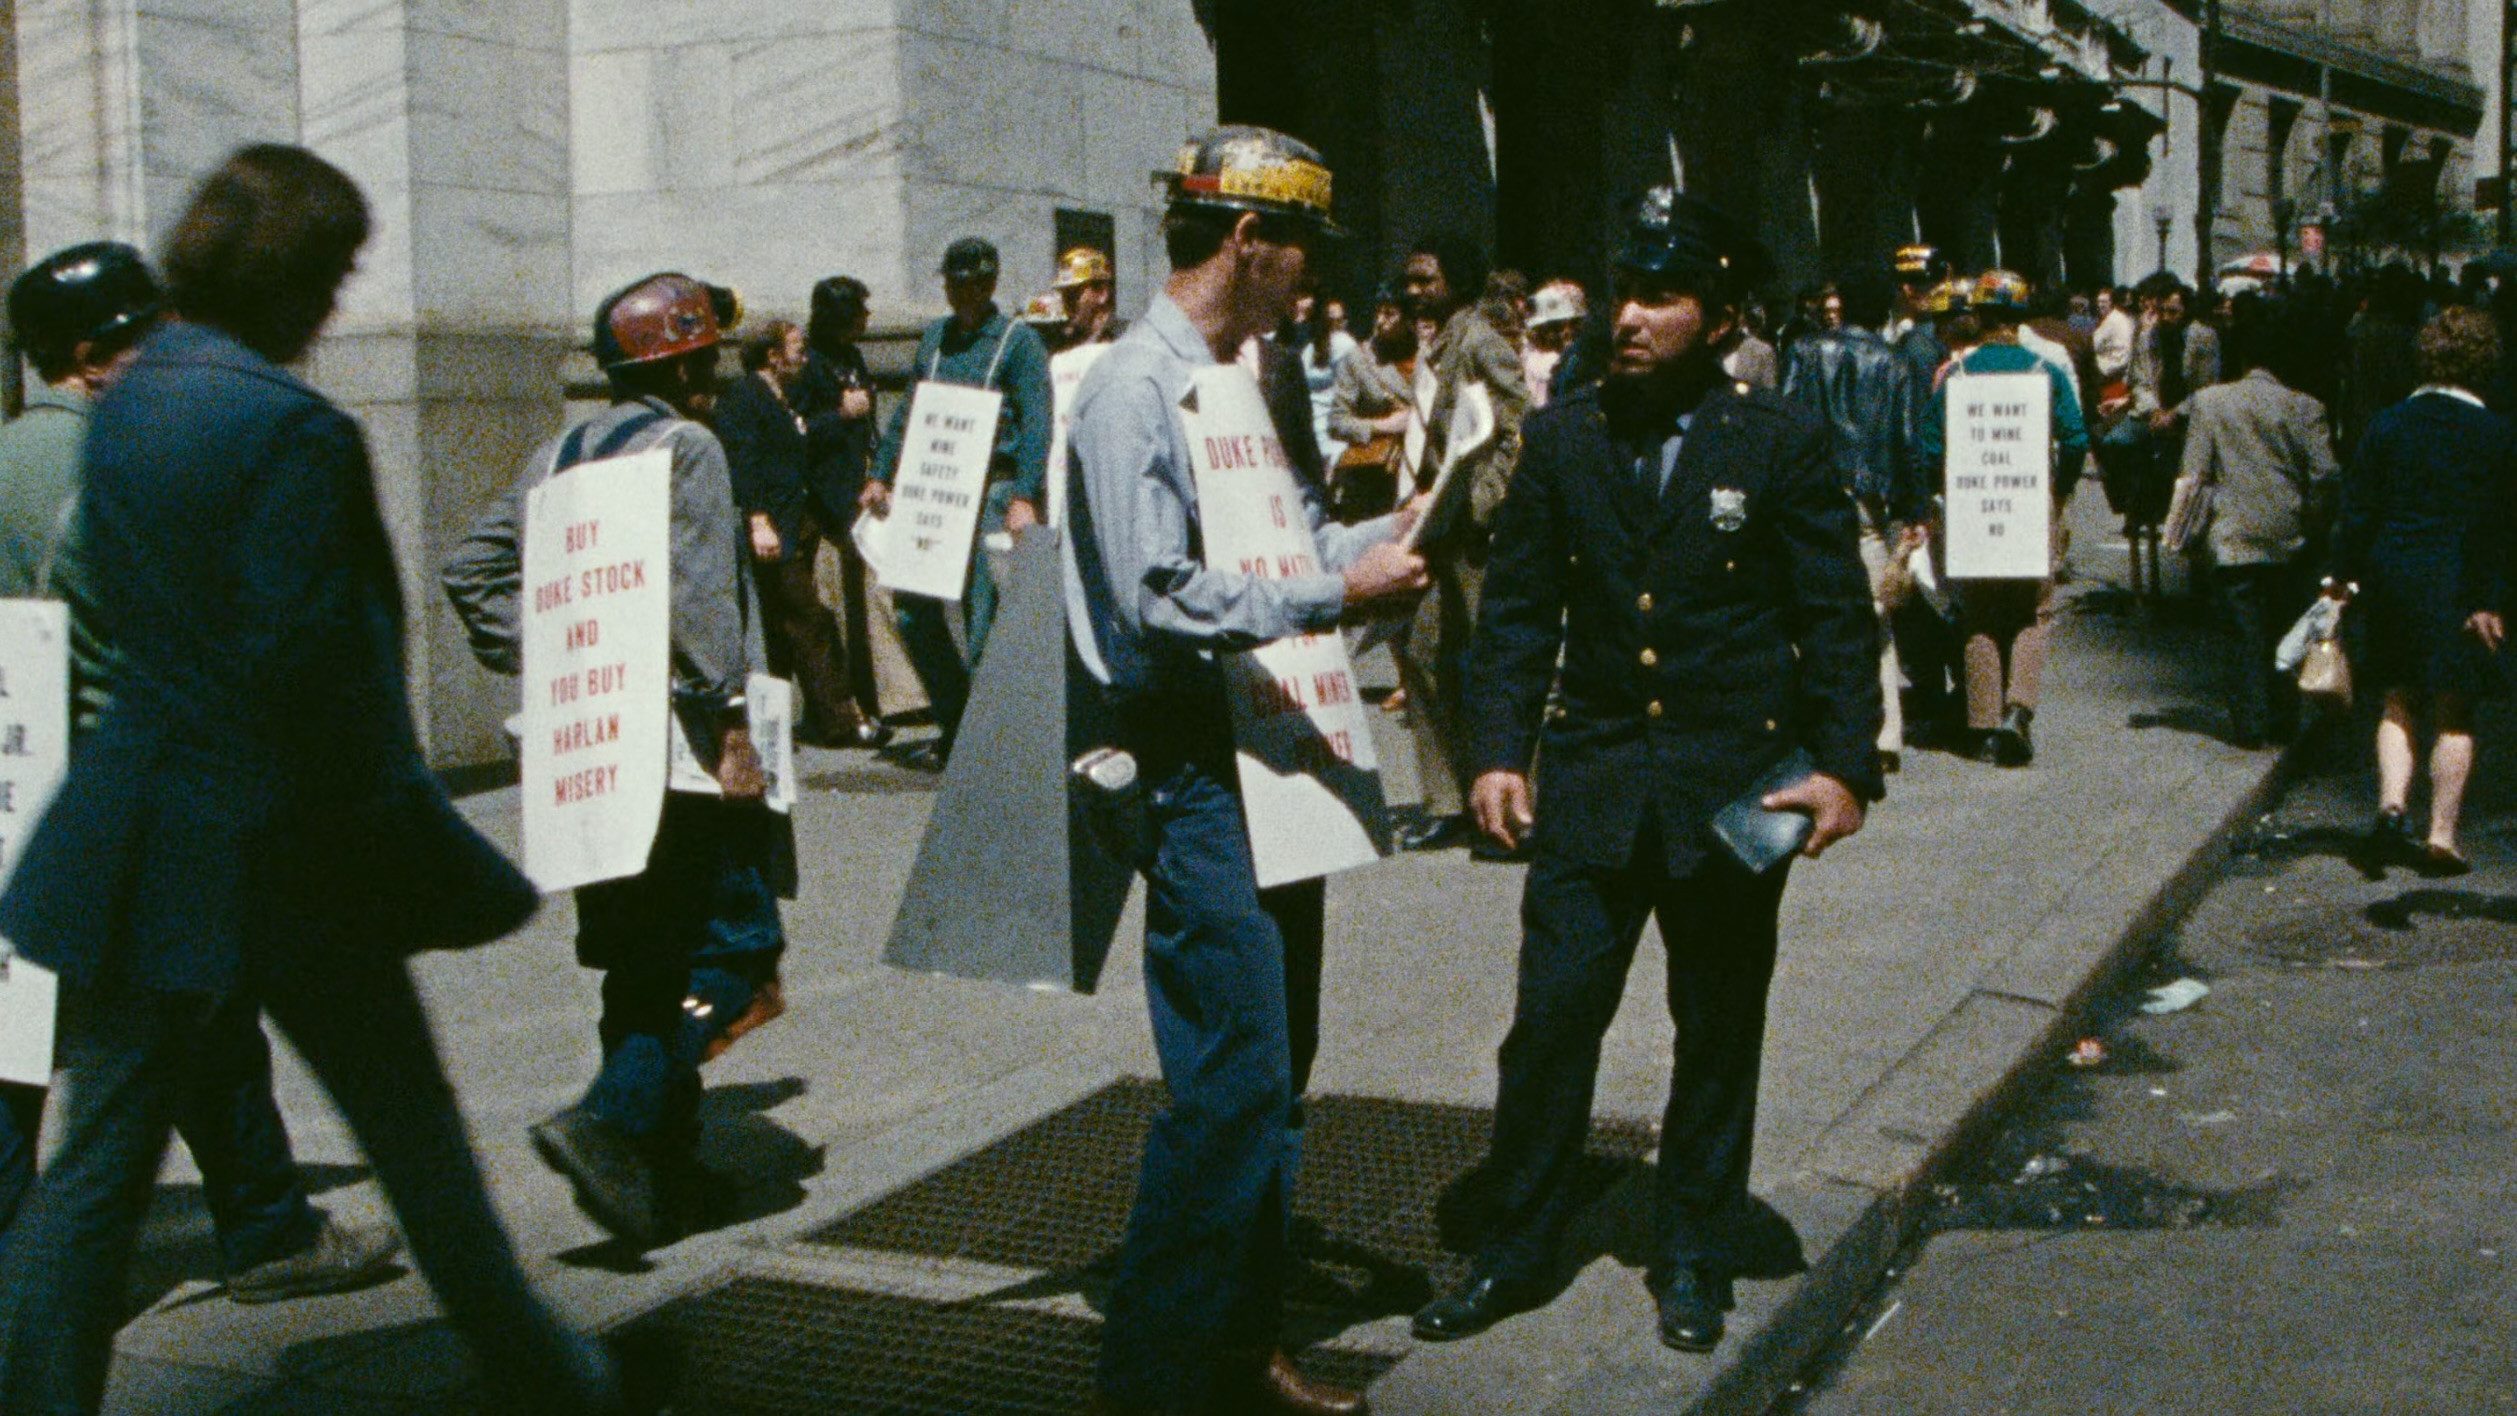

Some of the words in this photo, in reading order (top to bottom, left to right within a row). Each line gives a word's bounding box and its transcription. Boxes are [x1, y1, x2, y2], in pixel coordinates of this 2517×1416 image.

[1967, 403, 1984, 417] WE
[1993, 403, 2026, 418] WANT
[1971, 427, 1985, 442] TO
[1992, 427, 2021, 442] MINE
[1204, 435, 1258, 470] DUKE
[1981, 450, 2011, 466] COAL
[931, 489, 970, 508] POWER
[1956, 475, 1986, 490] DUKE
[1994, 475, 2037, 490] POWER
[1271, 495, 1288, 530] IS
[1981, 498, 2012, 514] SAYS
[566, 520, 599, 555] BUY
[1988, 522, 2005, 537] NO
[536, 574, 572, 614] DUKE
[582, 559, 645, 599] STOCK
[567, 618, 598, 652] AND
[551, 673, 578, 706] YOU
[588, 663, 625, 697] BUY
[554, 713, 619, 756] HARLAN
[555, 764, 617, 807] MISERY
